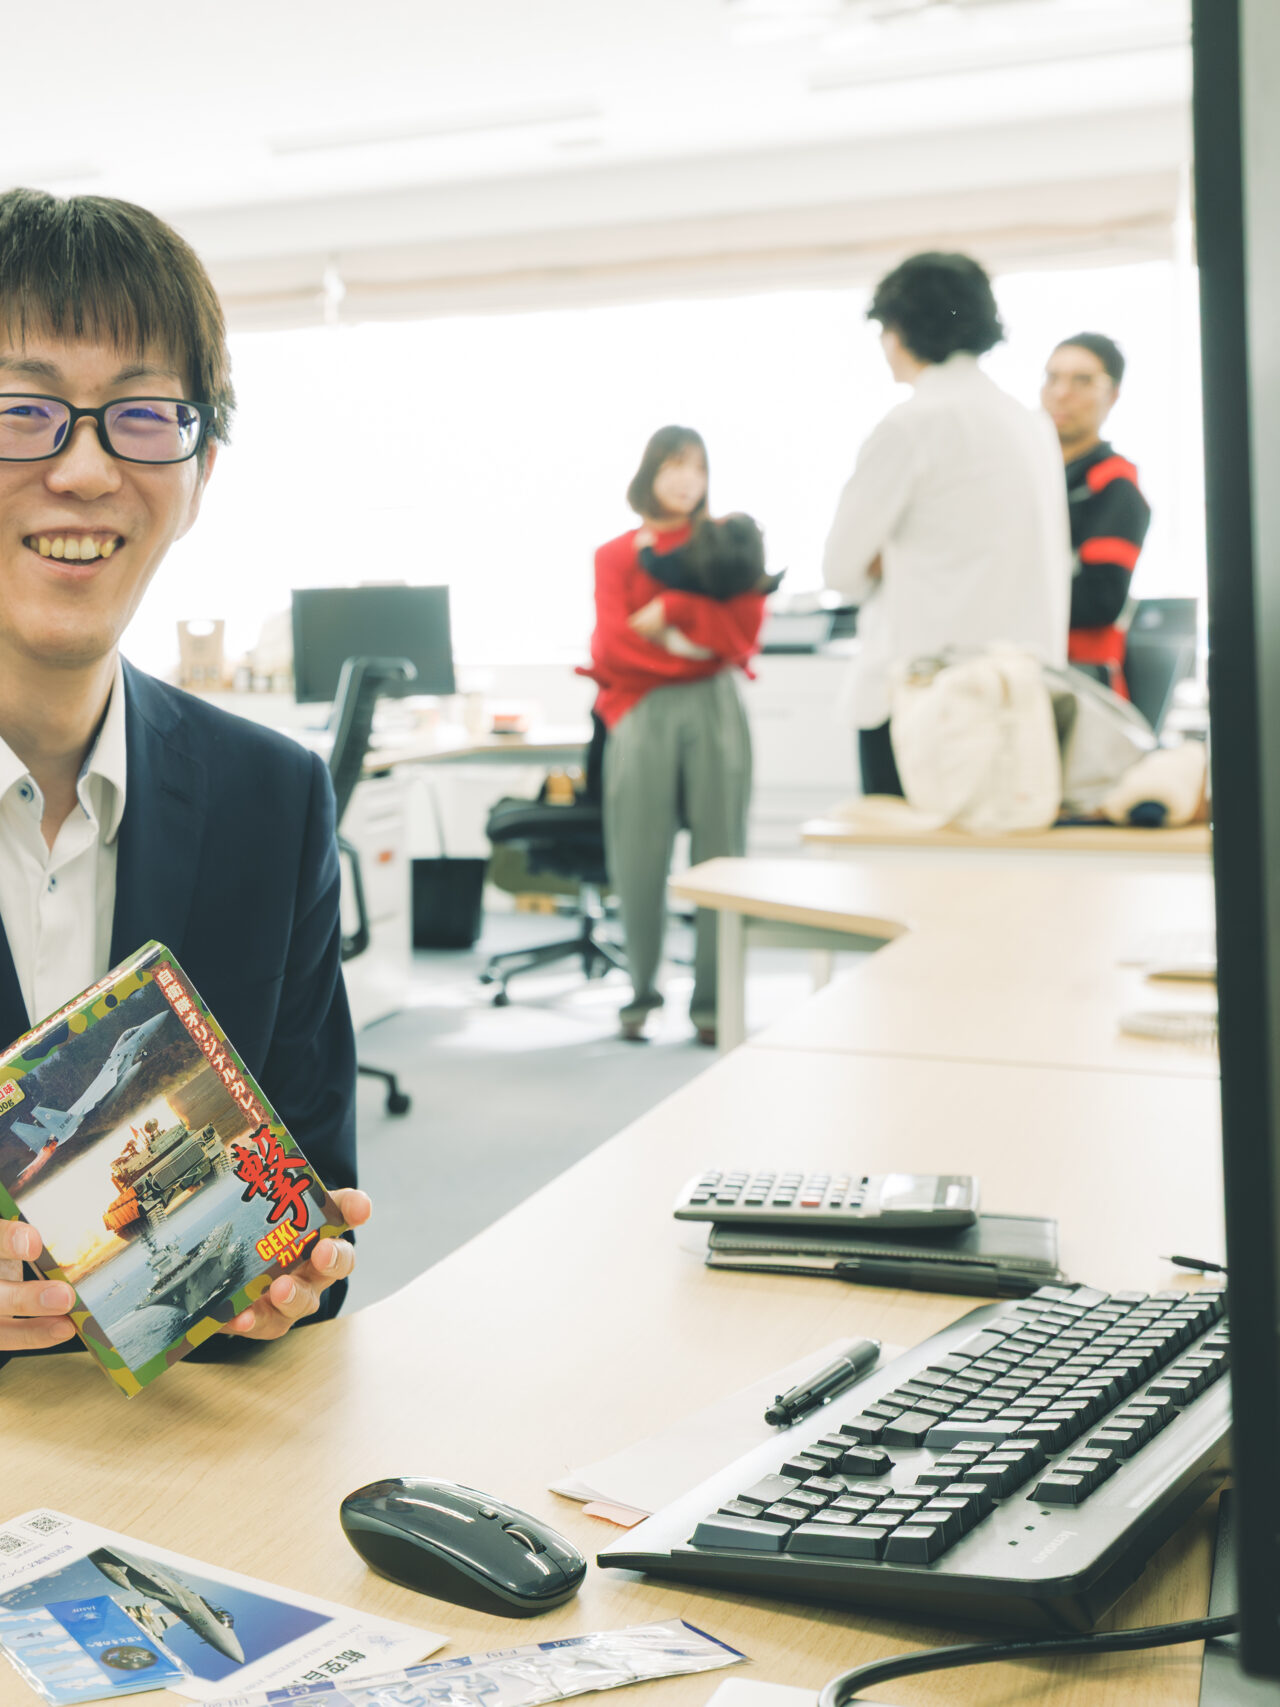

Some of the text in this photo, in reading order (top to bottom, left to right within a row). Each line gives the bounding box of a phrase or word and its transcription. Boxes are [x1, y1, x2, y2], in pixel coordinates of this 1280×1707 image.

[156, 969, 263, 1124] 自衛隊オリジナルカレー
[231, 1124, 314, 1230] 撃
[256, 1219, 297, 1263] GEKI
[277, 1230, 319, 1269] カレー
[285, 1649, 370, 1688] 航空自
